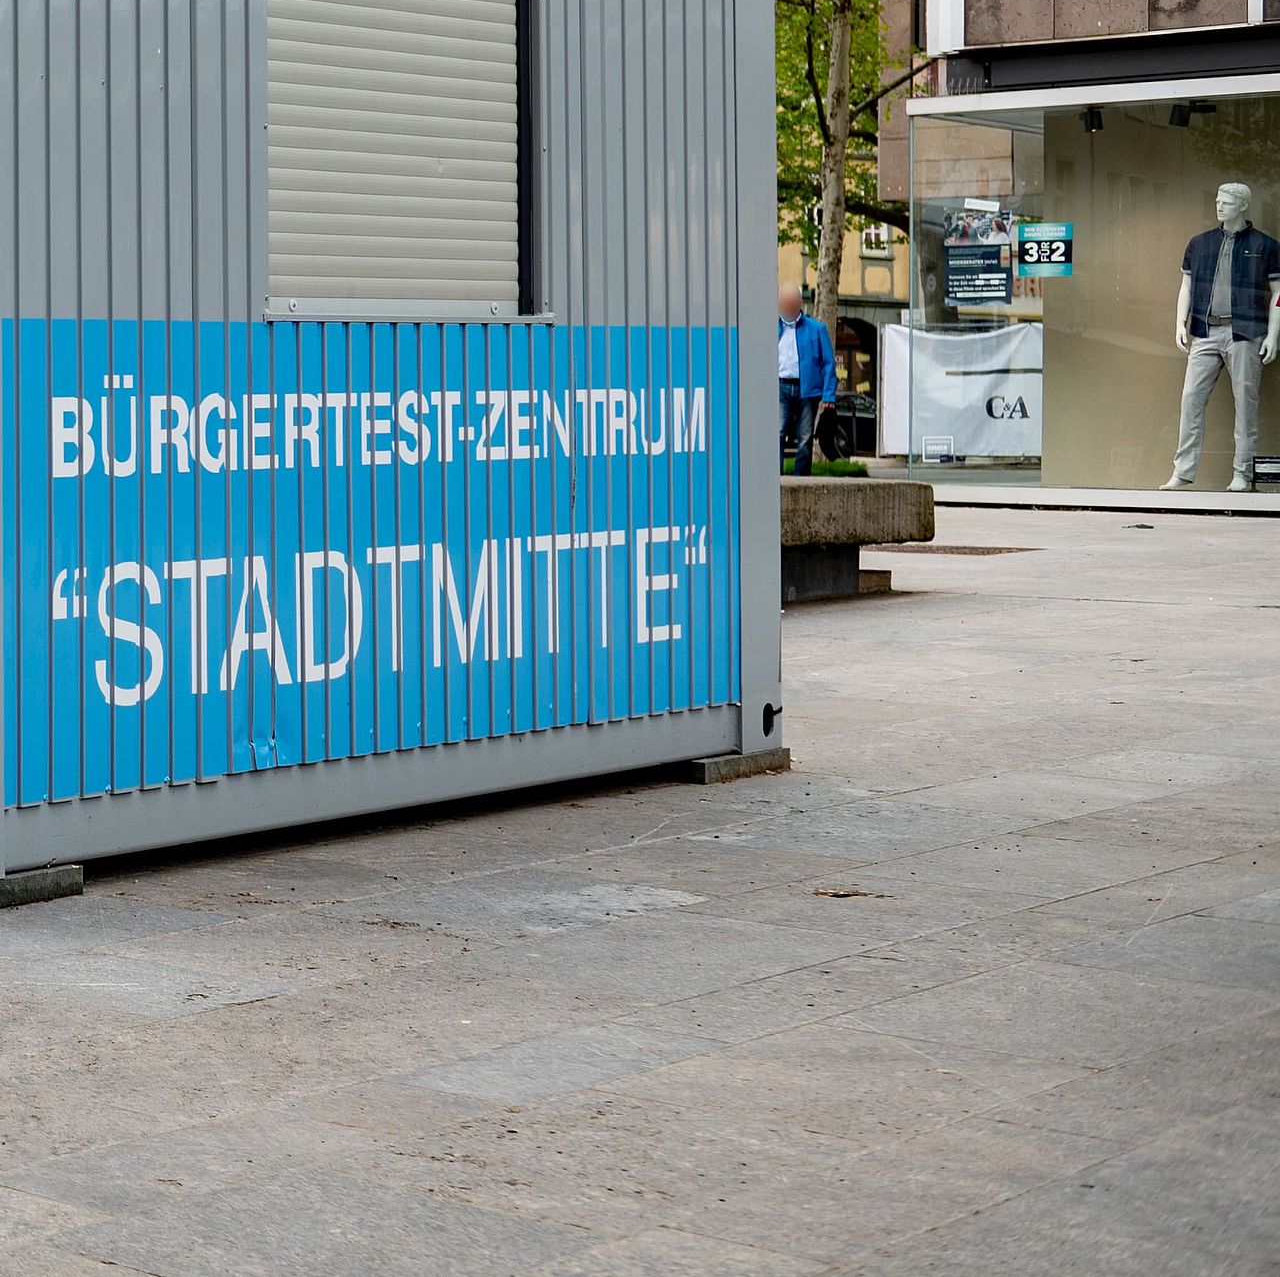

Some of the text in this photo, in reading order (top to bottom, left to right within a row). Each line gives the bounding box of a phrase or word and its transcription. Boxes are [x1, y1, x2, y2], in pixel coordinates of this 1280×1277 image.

[1024, 241, 1065, 262] 3 FÜR 2
[986, 396, 1030, 419] C&A
[52, 374, 706, 478] BÜRGERTEST-ZENTRUM
